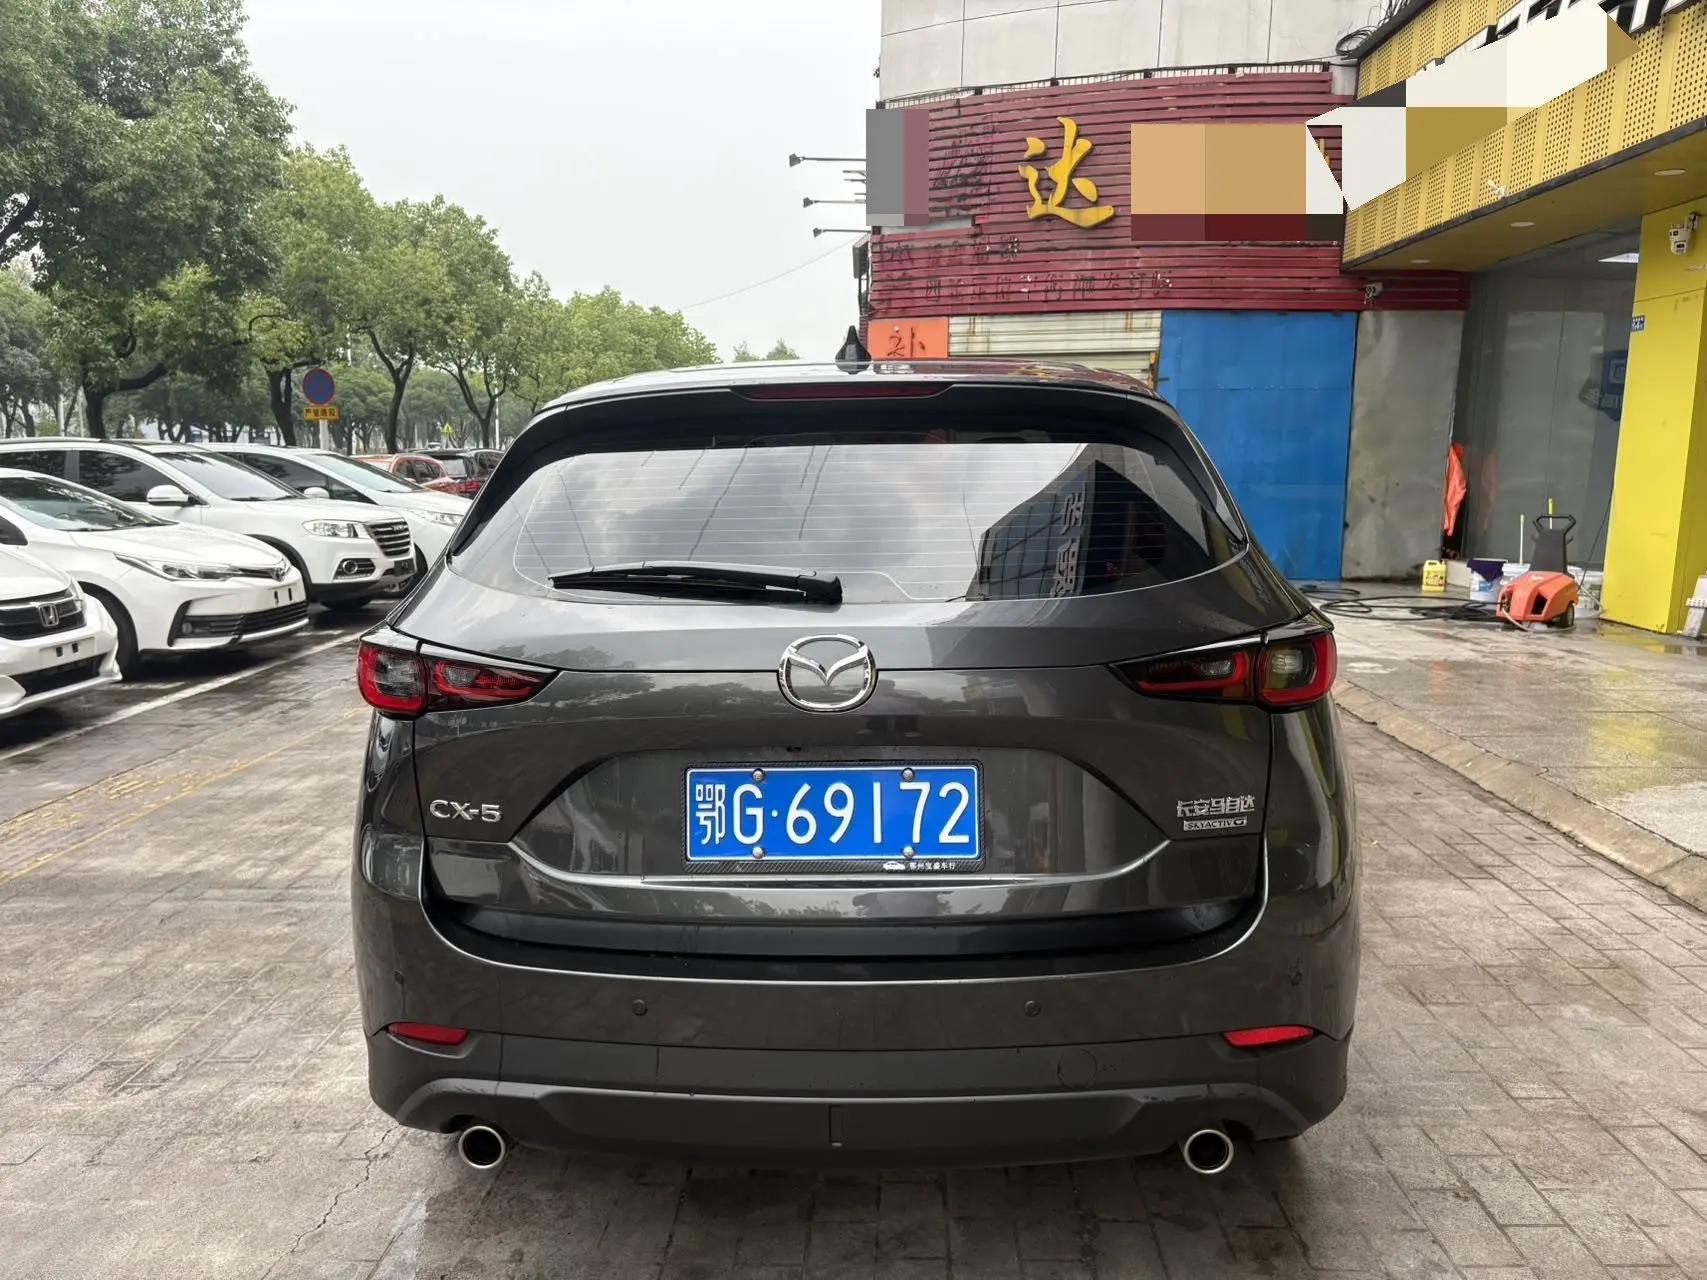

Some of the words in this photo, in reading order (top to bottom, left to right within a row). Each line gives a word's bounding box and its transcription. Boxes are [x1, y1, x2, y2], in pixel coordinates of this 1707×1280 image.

[1018, 116, 1115, 228] 达
[429, 799, 501, 822] CX-5
[695, 781, 970, 845] 鄂G·69172
[1177, 795, 1255, 817] 长安马自达
